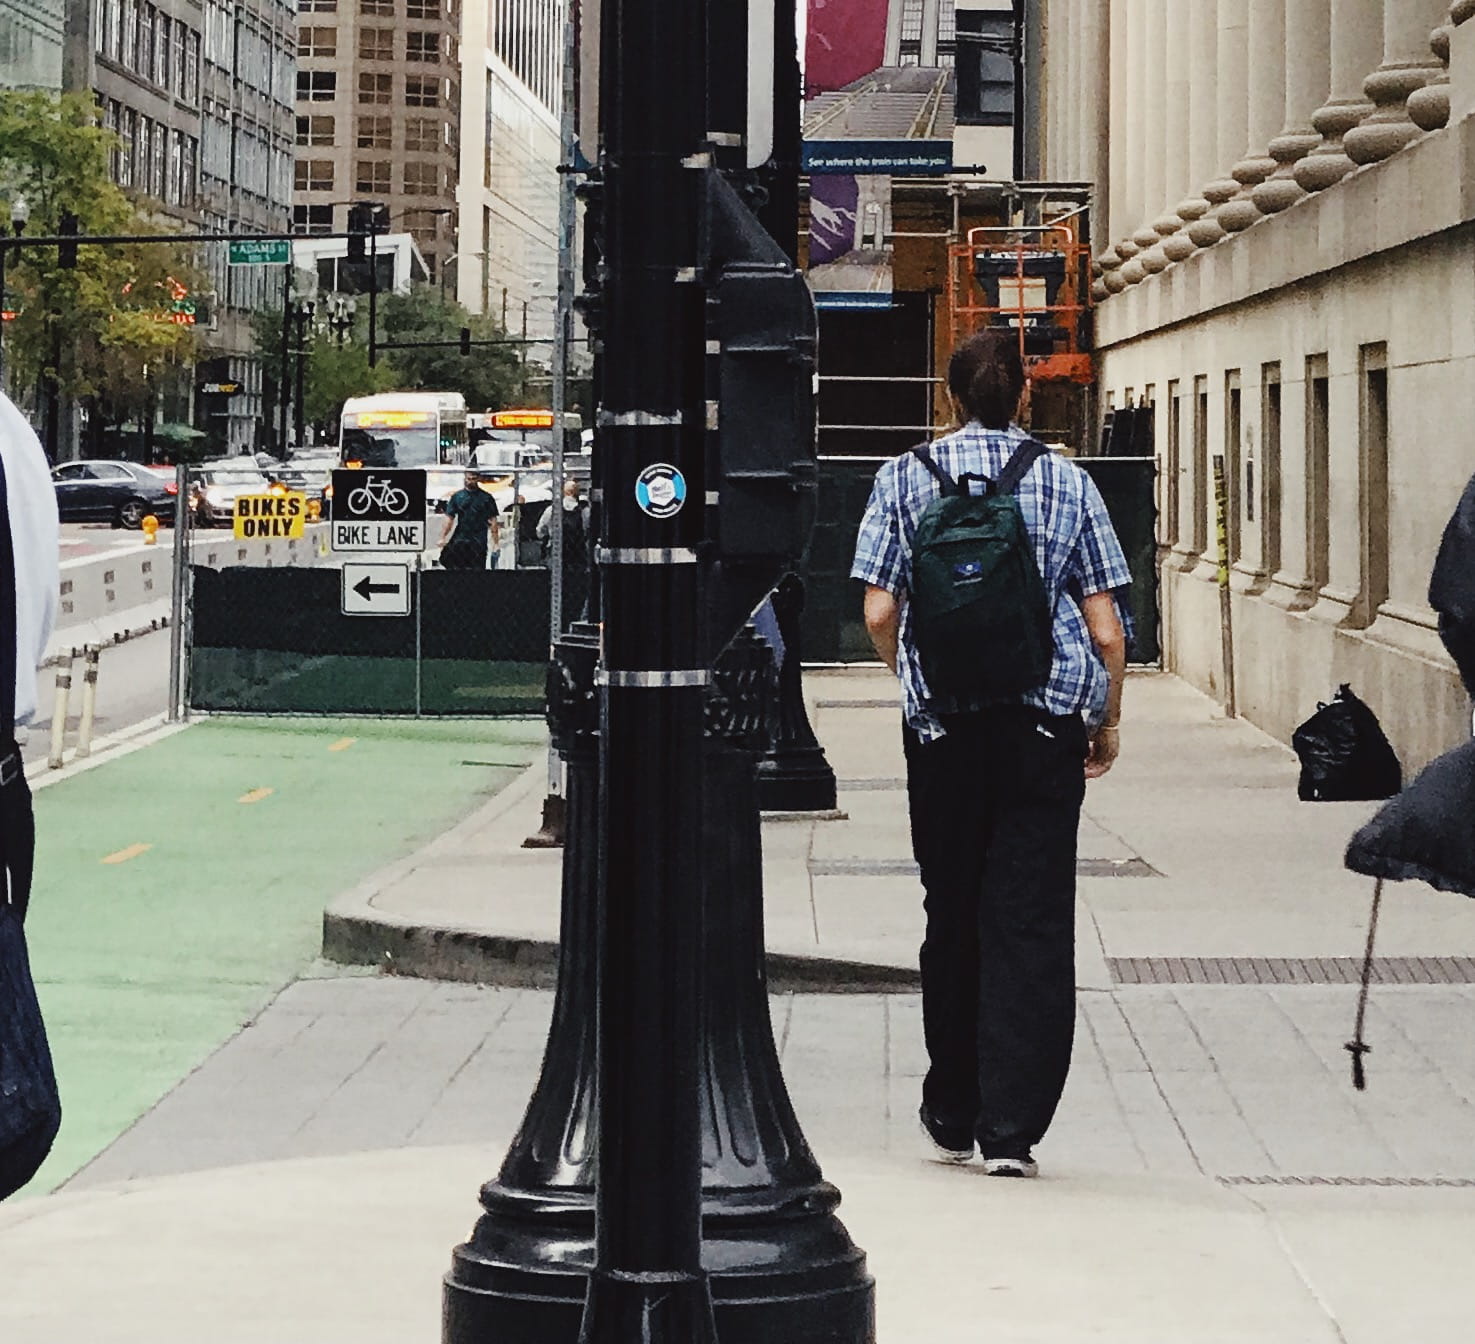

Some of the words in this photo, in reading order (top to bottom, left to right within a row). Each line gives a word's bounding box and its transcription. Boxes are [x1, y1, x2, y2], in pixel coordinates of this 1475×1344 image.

[808, 157, 825, 167] See
[826, 157, 854, 167] where
[855, 157, 870, 166] the
[872, 157, 892, 166] train
[893, 158, 908, 166] can
[909, 156, 928, 166] take
[929, 158, 946, 167] you
[239, 243, 276, 254] ADAMS
[238, 498, 300, 516] BIKES
[243, 519, 293, 537] ONLY
[337, 526, 370, 545] BIKE
[377, 526, 419, 545] LANE
